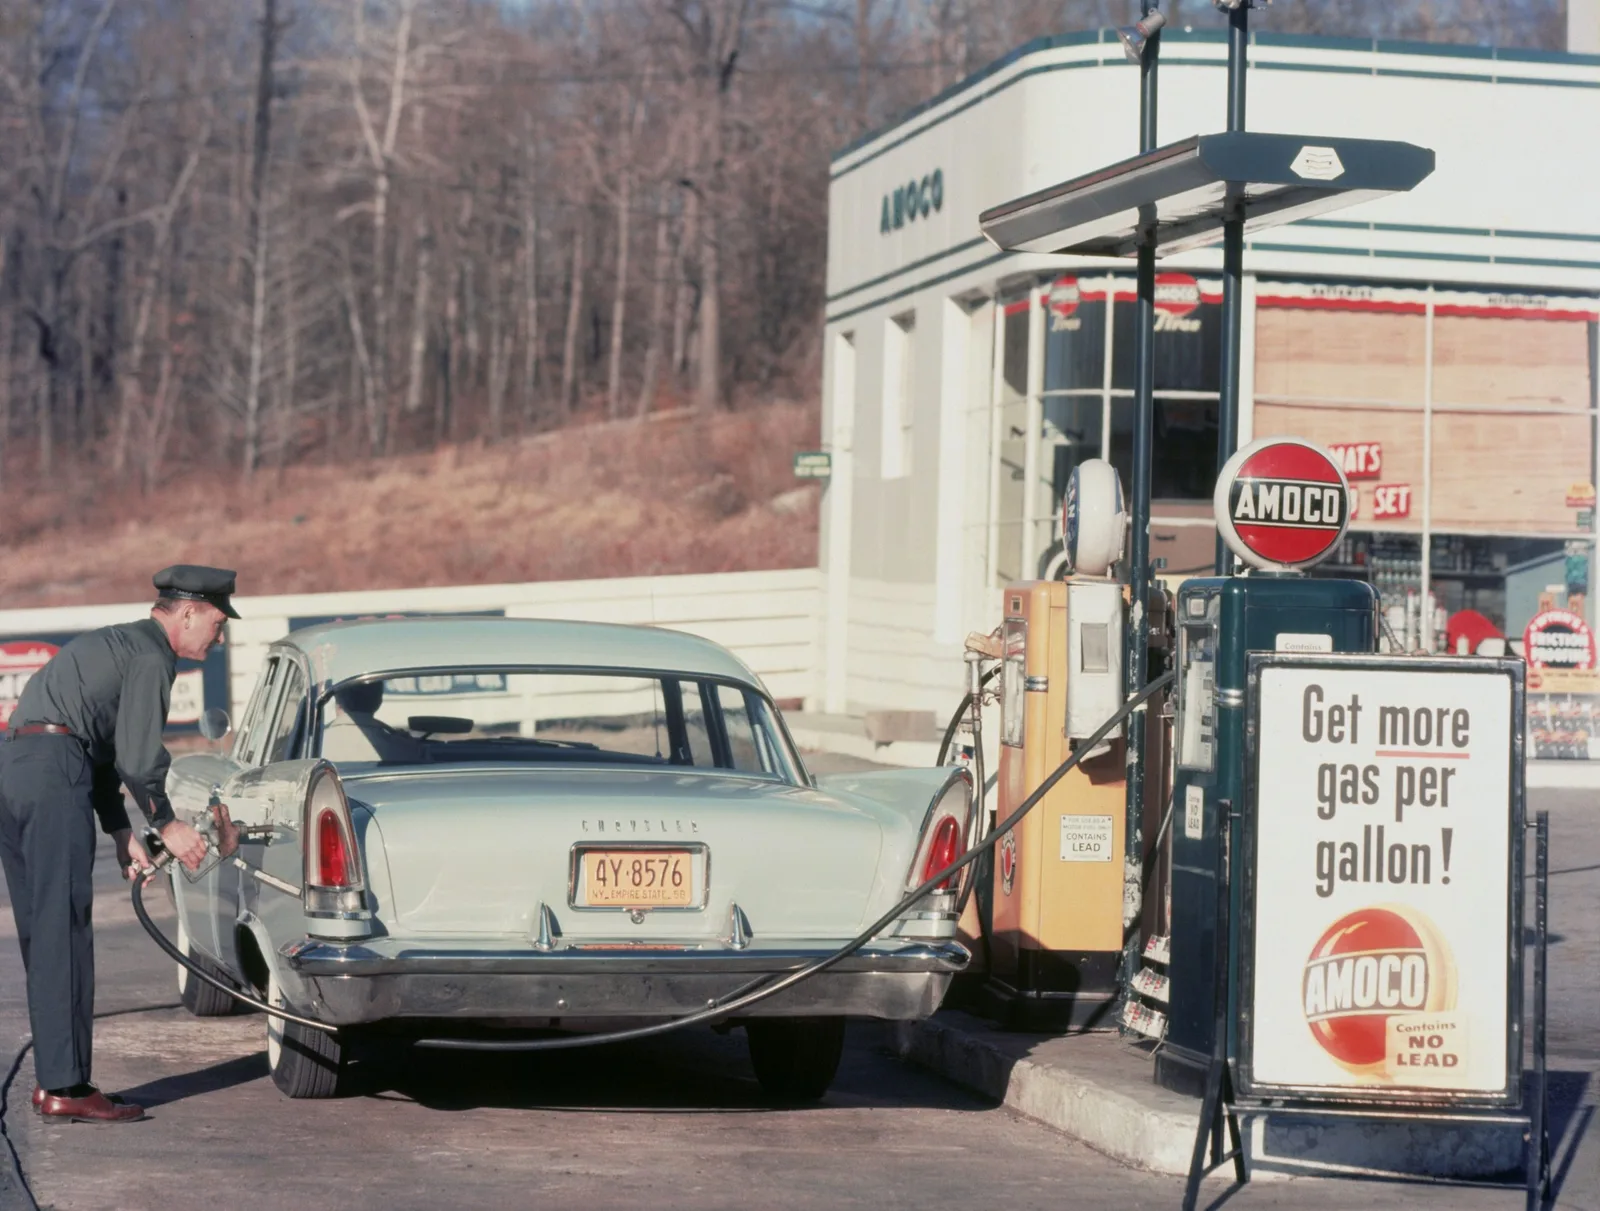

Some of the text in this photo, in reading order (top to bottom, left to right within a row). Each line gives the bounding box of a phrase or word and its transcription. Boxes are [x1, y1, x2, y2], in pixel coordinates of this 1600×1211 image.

[879, 166, 944, 236] AMOCO
[1234, 482, 1340, 524] AMOCO
[1374, 486, 1410, 515] SET
[1302, 683, 1470, 748] Get more
[1317, 762, 1456, 822] gas per
[581, 819, 699, 834] CHRYSLER
[1066, 833, 1107, 841] CONTAINS
[1072, 843, 1101, 852] LEAD
[610, 889, 640, 899] EMPIRE
[1305, 954, 1426, 1019] AMOCO
[1396, 1021, 1457, 1033] Contains
[1408, 1035, 1444, 1049] NO
[1396, 1053, 1459, 1068] LEAD
